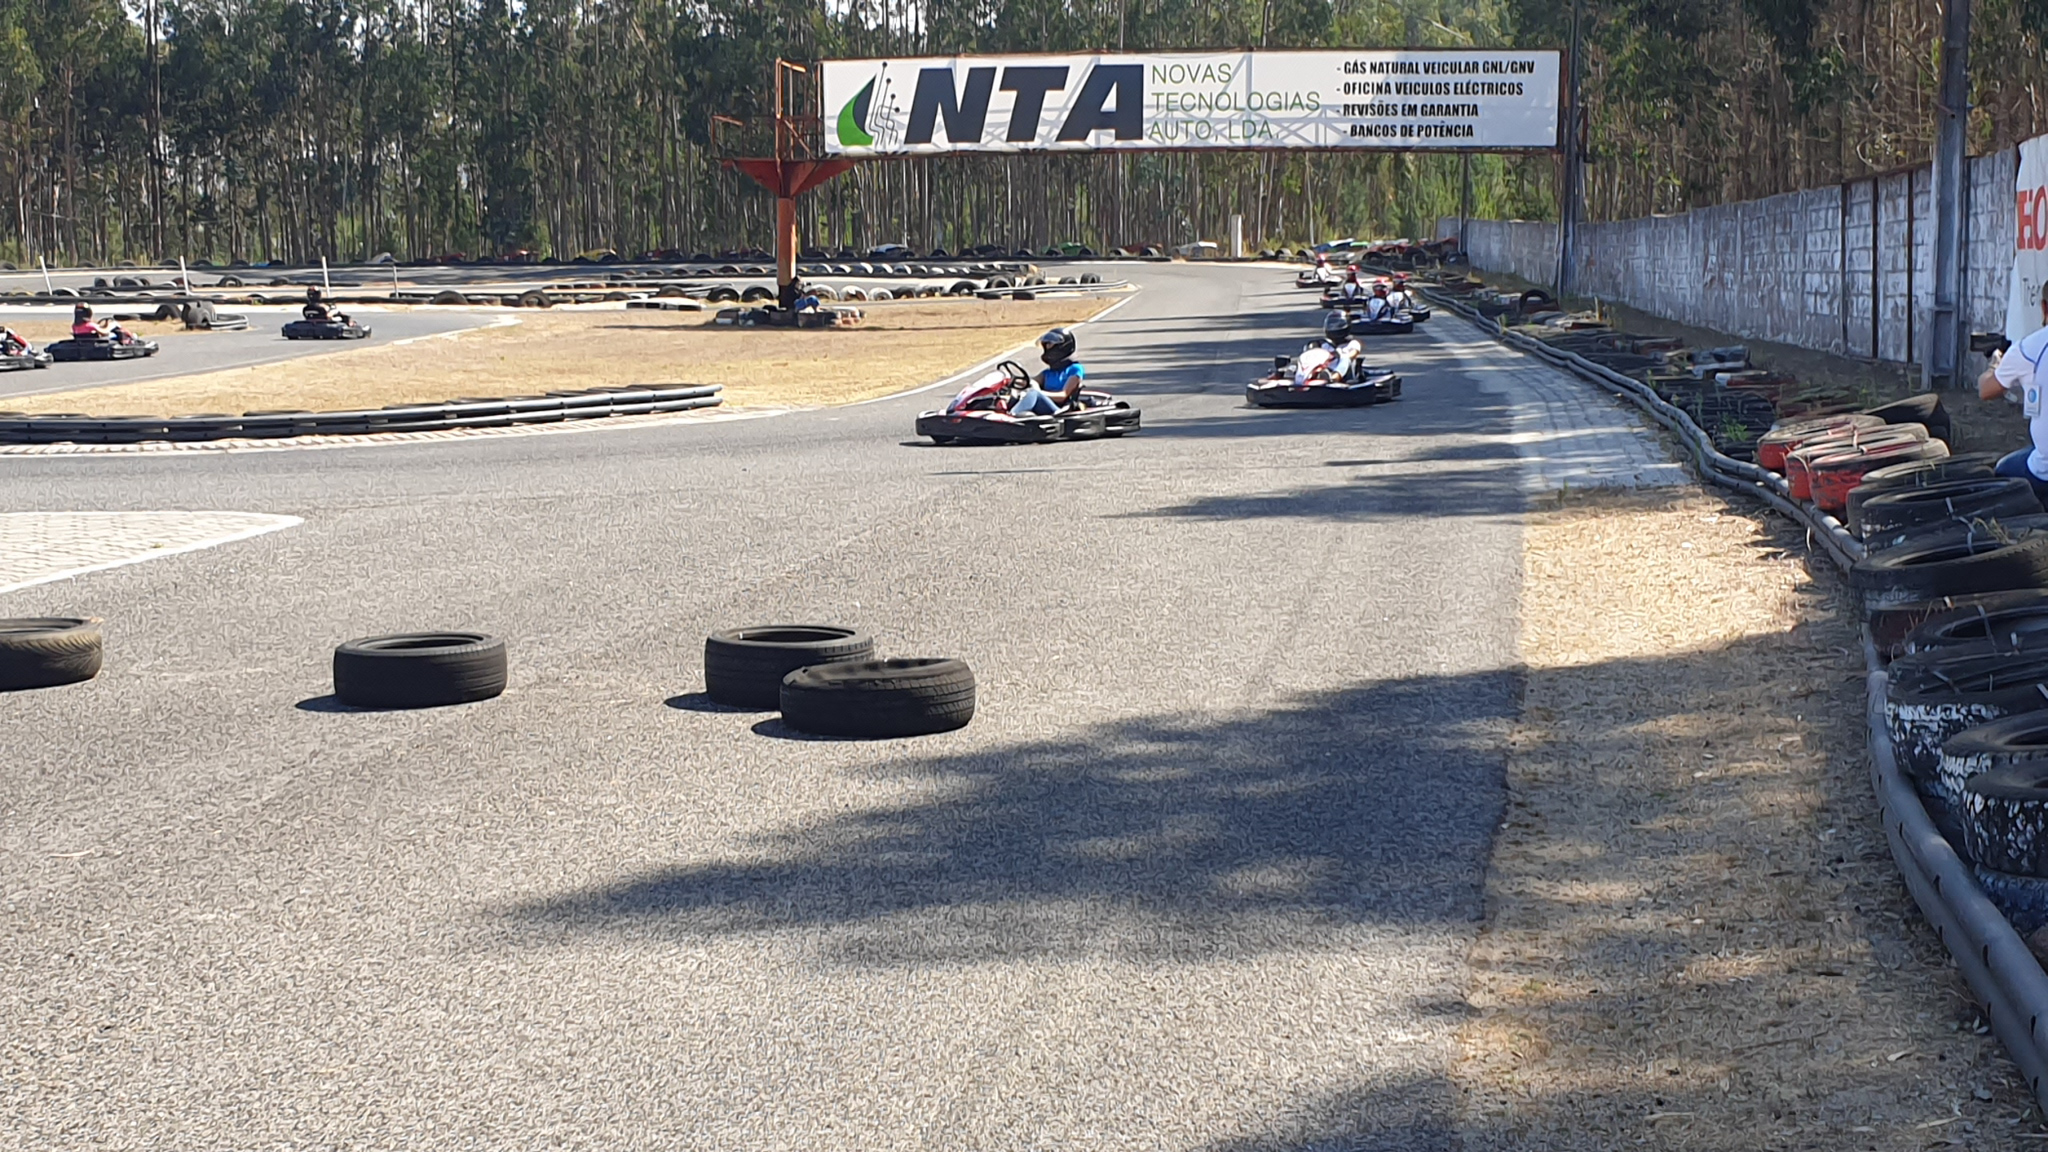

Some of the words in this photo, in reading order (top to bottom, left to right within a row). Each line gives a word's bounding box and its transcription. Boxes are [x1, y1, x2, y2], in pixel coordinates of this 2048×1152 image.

[1152, 63, 1232, 84] NOVAS
[1344, 59, 1367, 75] GÁS
[1369, 61, 1421, 75] NATURAL
[1423, 61, 1480, 75] VEICULAR
[1482, 60, 1535, 75] GNL/GNV
[1343, 82, 1392, 96] OFICINA
[1394, 82, 1451, 96] VEICULOS
[1453, 79, 1524, 96] ELÉCTRICOS
[904, 64, 1145, 144] NTA
[1151, 91, 1321, 112] TECNOLOGIAS
[1343, 99, 1398, 117] REVISÕES
[1401, 104, 1418, 117] EM
[1420, 103, 1479, 117] GARANTIA
[1148, 120, 1219, 142] AUTO,
[1350, 124, 1397, 138] BANCOS
[1400, 124, 1415, 138] DE
[1416, 120, 1474, 138] POTÊNCIA
